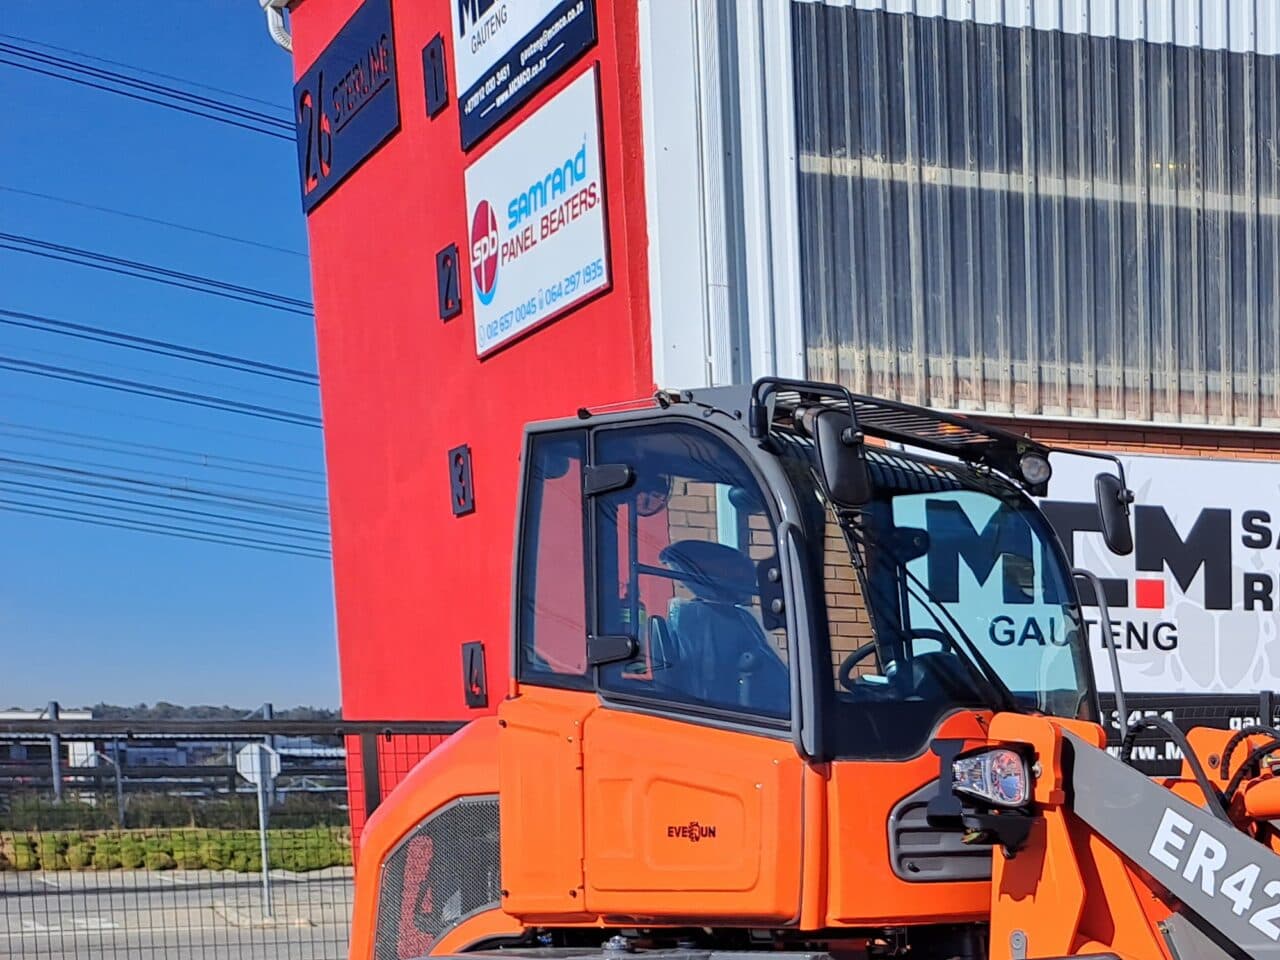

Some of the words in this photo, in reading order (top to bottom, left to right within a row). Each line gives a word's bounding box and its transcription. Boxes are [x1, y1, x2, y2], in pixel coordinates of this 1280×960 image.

[470, 4, 507, 54] GAUTENG
[300, 70, 331, 195] 26
[501, 224, 537, 267] PANEL
[442, 254, 455, 310] 2
[486, 320, 499, 340] 012
[500, 310, 514, 332] 657
[515, 297, 537, 323] 0045
[545, 281, 563, 305] 064
[564, 270, 581, 295] 297
[582, 258, 603, 285] 1935
